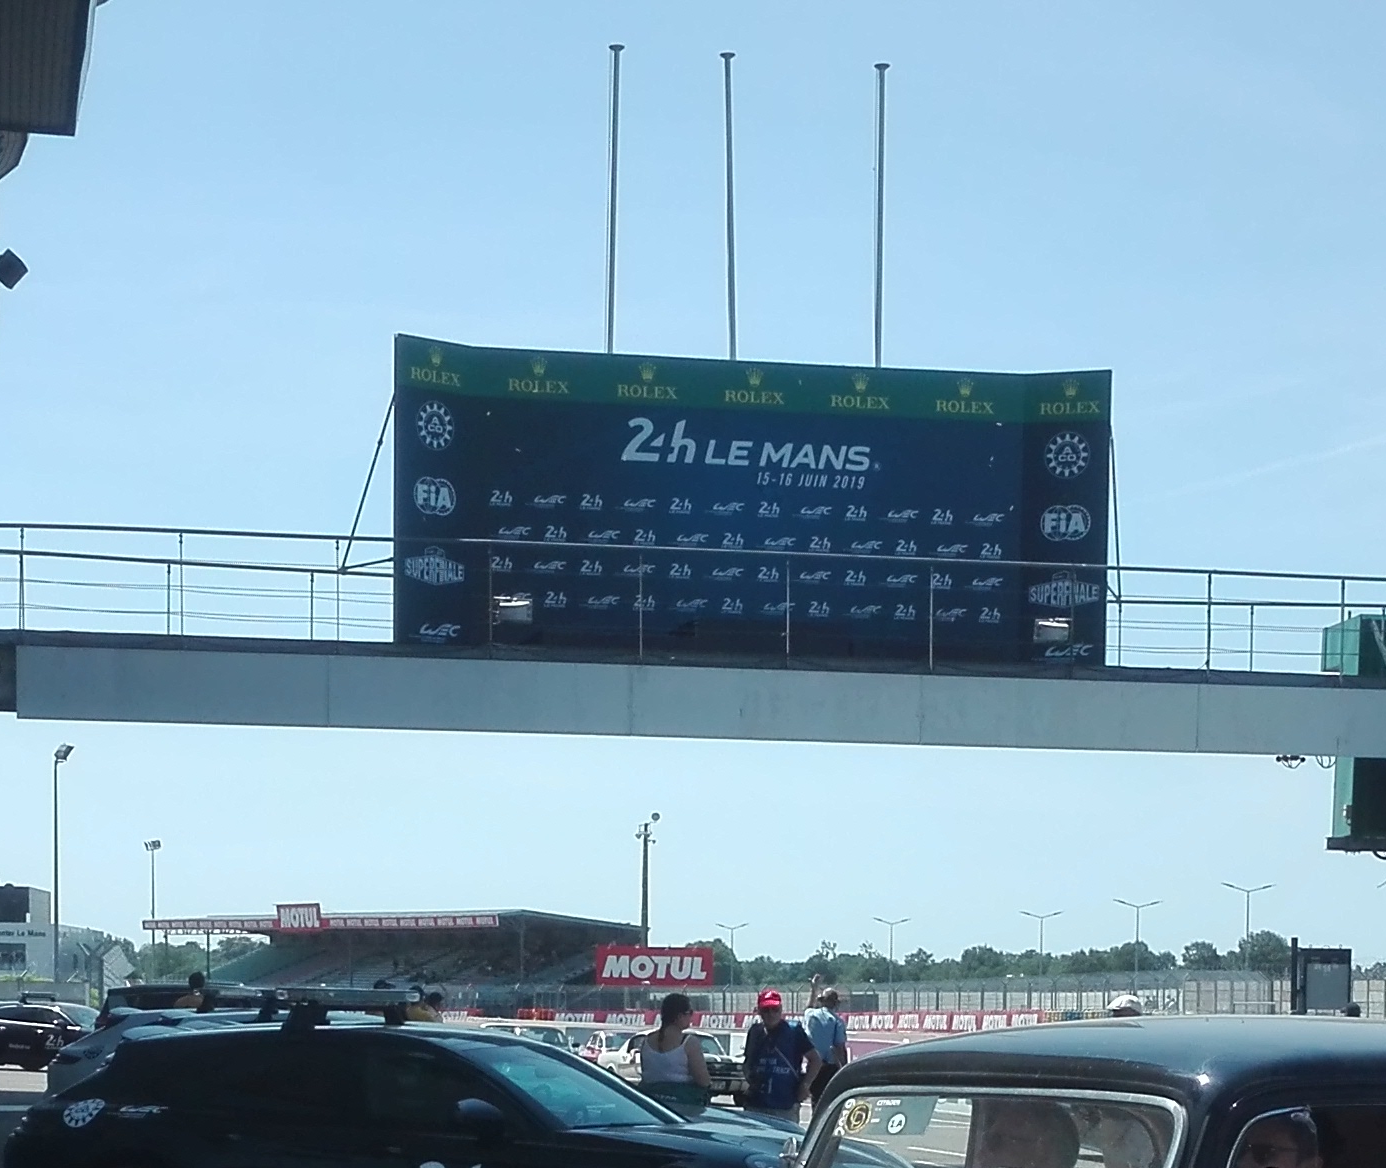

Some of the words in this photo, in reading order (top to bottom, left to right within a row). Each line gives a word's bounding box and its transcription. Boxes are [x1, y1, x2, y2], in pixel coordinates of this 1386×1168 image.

[410, 366, 461, 387] ROLEX
[508, 378, 570, 394] ROLEX
[617, 384, 678, 399] ROLEX
[725, 390, 784, 405] ROLEX
[830, 395, 890, 410] ROLEX
[935, 400, 994, 415] ROLEX
[1040, 400, 1100, 416] ROLEX
[621, 417, 697, 464] 24h
[704, 439, 754, 466] LE
[759, 441, 871, 472] MANS
[756, 471, 793, 487] 15-16
[797, 474, 829, 488] JUIN
[833, 475, 865, 490] 2019
[280, 907, 320, 929] MOTUL
[602, 955, 707, 980] MOTUL
[605, 1013, 645, 1027] MOTUL
[699, 1014, 736, 1028] MOTUL
